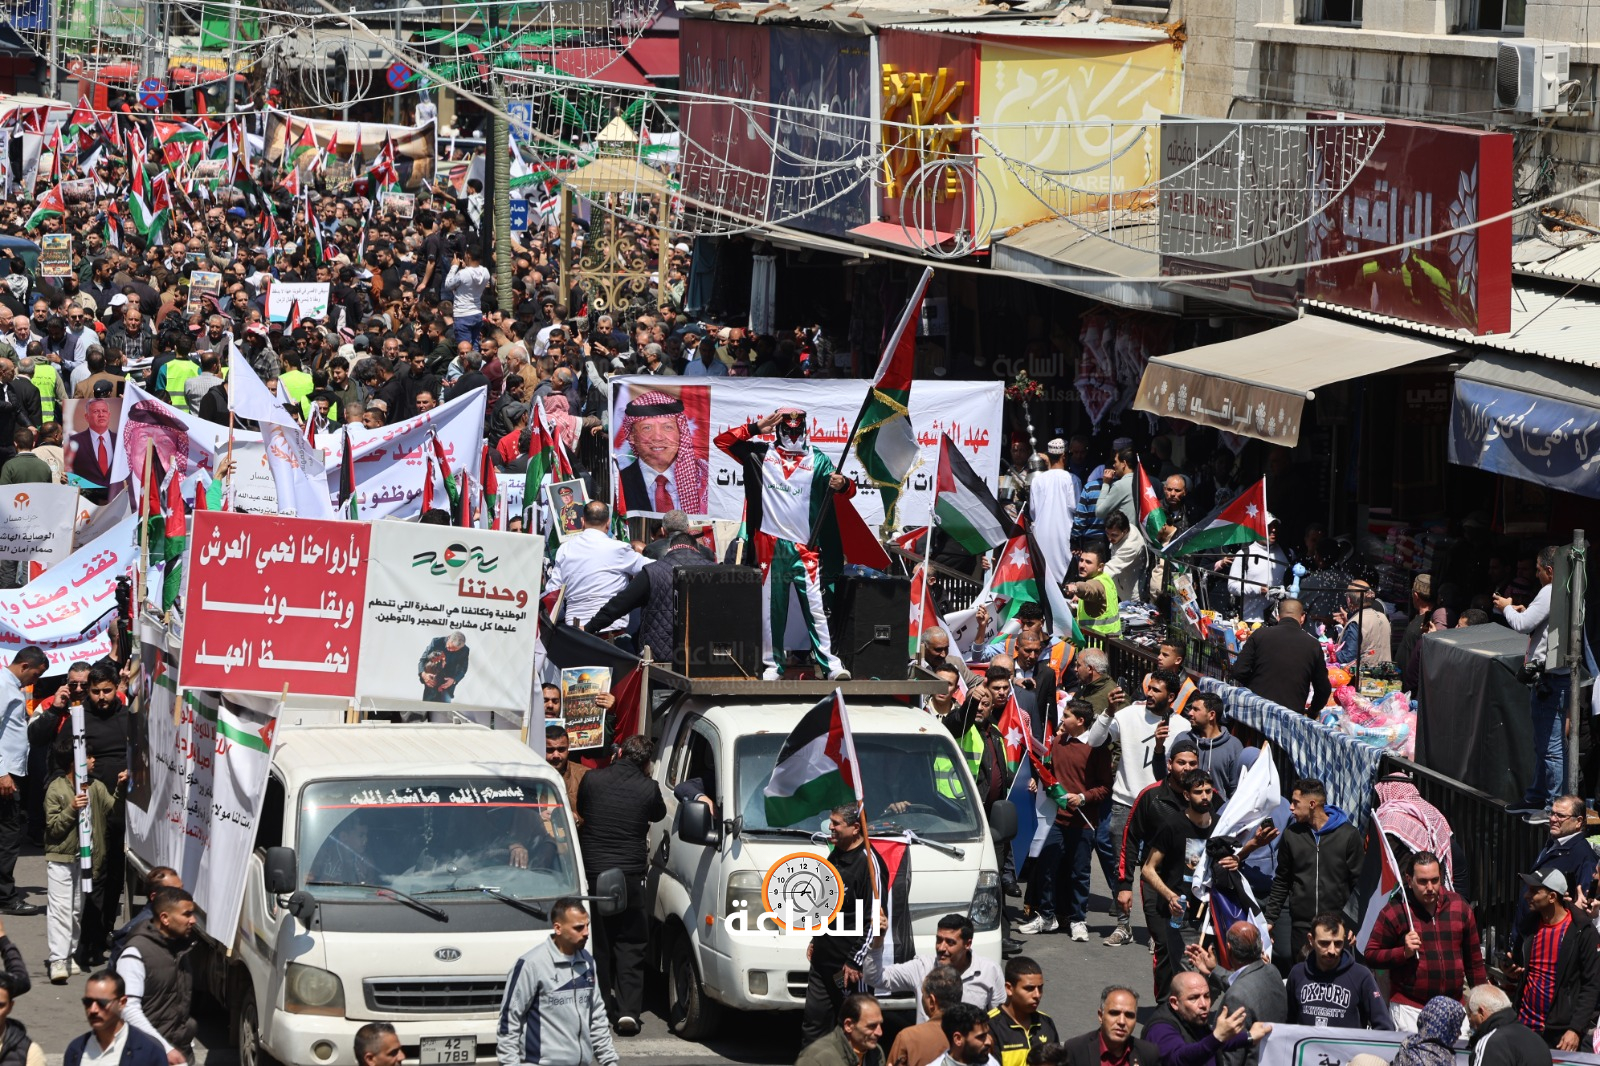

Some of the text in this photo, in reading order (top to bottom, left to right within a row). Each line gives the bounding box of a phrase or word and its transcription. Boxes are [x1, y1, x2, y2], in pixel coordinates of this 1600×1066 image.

[1342, 179, 1433, 263] الراقي
[1190, 397, 1253, 425] الراقي
[964, 424, 990, 454] عهد
[199, 525, 360, 576] بأرواحنا نحمي العرش
[458, 577, 528, 609] وحدتنا
[397, 600, 415, 613] التي
[415, 602, 445, 614] الصخرة
[446, 604, 460, 618] هي
[495, 607, 527, 621] الوطنية
[417, 616, 448, 627] التهجير
[449, 619, 478, 630] مشاريع
[479, 621, 493, 631] كل
[494, 622, 517, 633] عليها
[195, 638, 350, 675] نحفظ العهد
[350, 789, 384, 805] الله
[438, 949, 457, 959] KIA
[1301, 982, 1351, 1008] OXFORD
[1303, 1006, 1346, 1018] UNIVERSITY
[445, 1038, 461, 1050] 42
[437, 1050, 469, 1063] 1789
